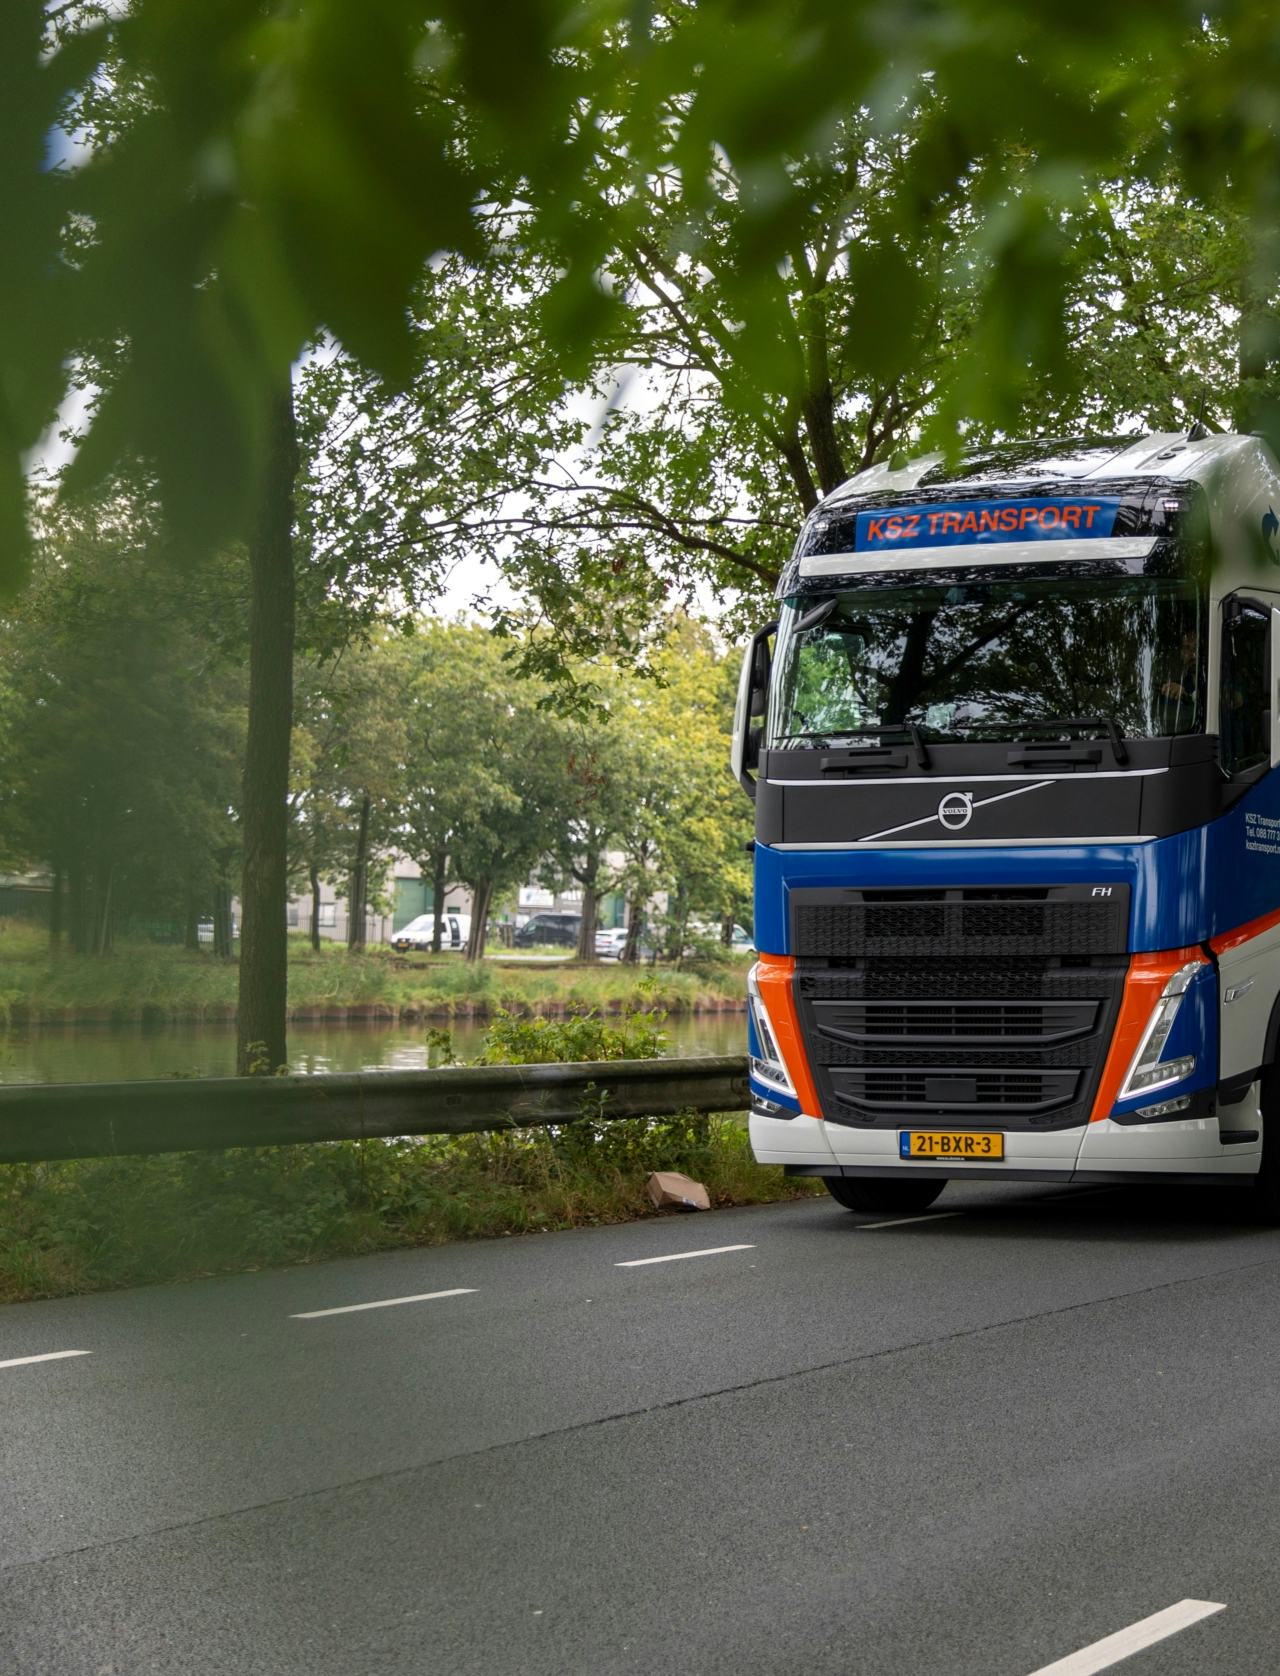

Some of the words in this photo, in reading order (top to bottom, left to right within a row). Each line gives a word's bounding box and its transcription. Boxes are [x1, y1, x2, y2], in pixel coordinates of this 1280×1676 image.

[867, 514, 919, 541] KSZ
[926, 506, 1101, 535] TRANSPORT
[1245, 812, 1257, 824] KSZ
[1257, 814, 1280, 828] Transport
[1246, 826, 1256, 837] Tel.
[1267, 829, 1277, 840] 777
[1091, 887, 1112, 897] FH
[917, 1135, 991, 1153] 21-BXR-3
